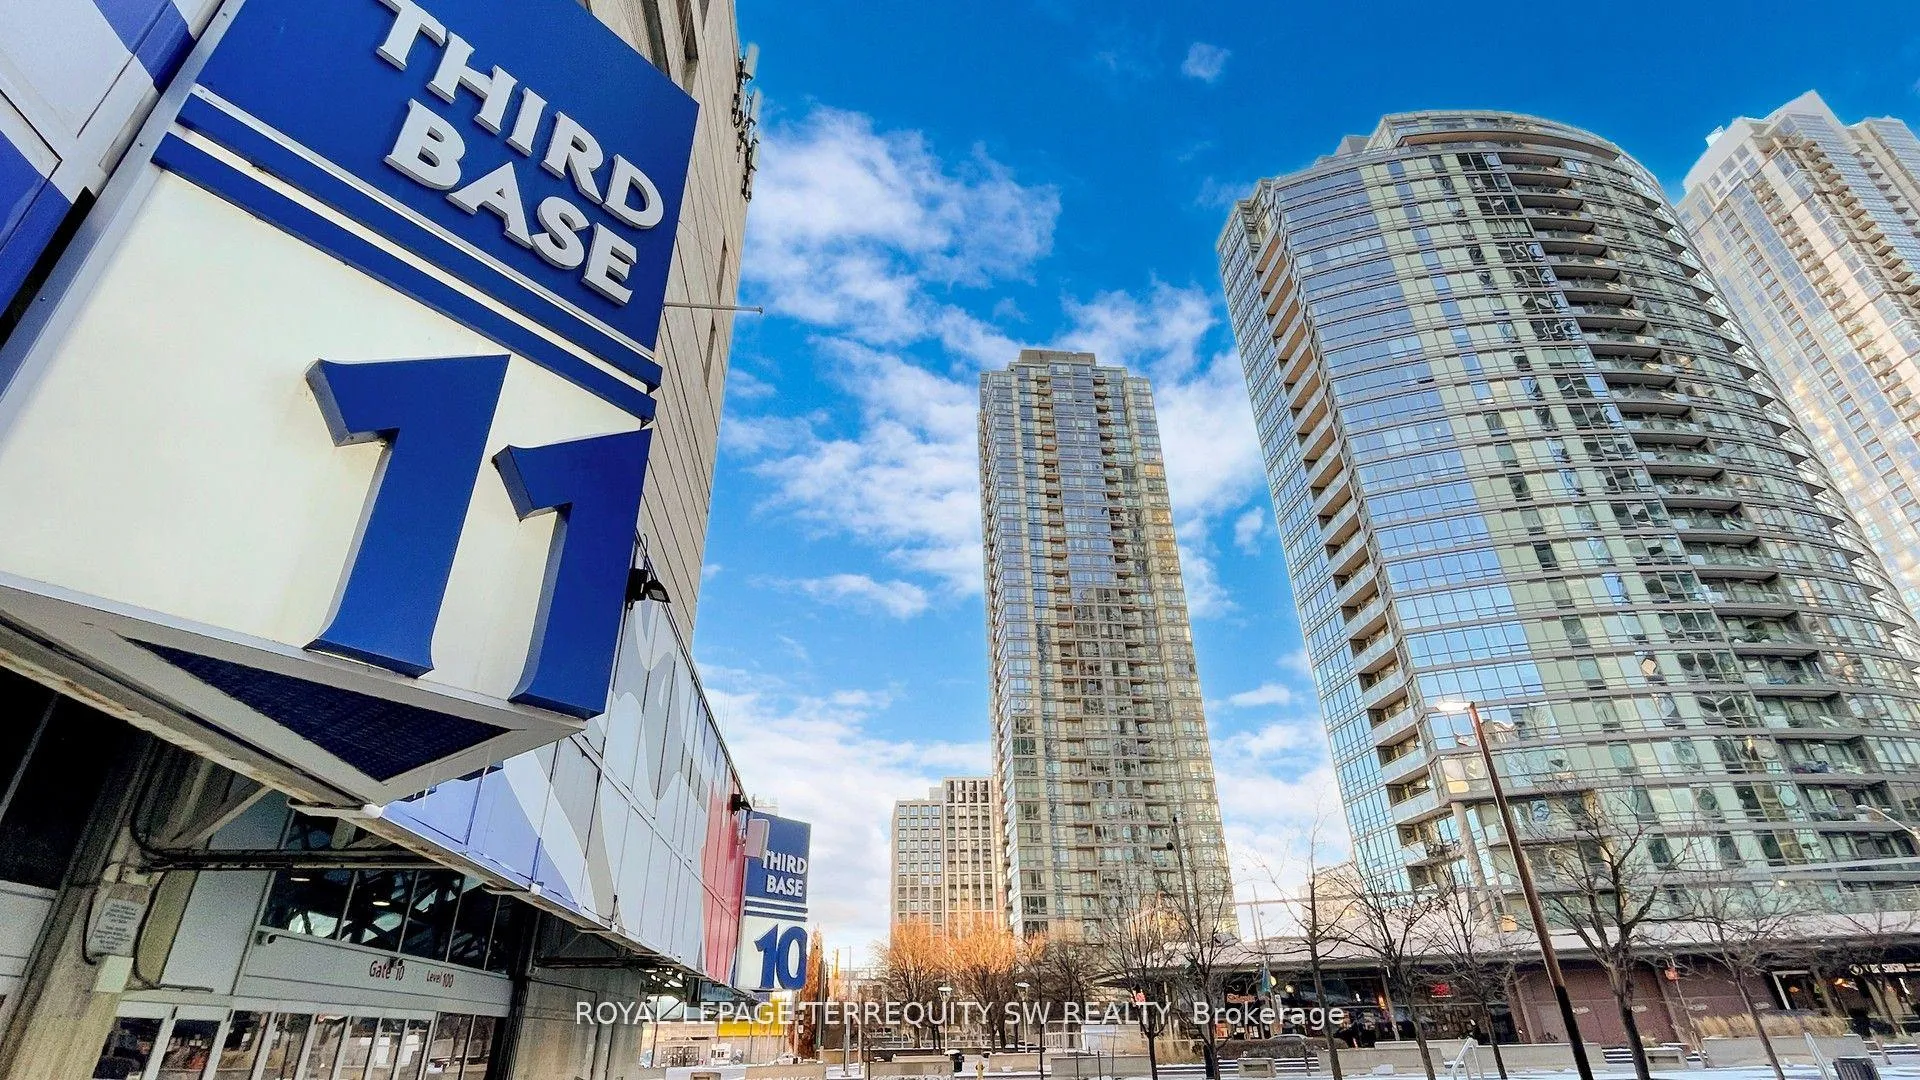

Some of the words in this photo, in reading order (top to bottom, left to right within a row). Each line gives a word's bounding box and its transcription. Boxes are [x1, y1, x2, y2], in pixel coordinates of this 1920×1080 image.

[376, 0, 664, 229] THIRD
[384, 98, 637, 306] BASE
[305, 354, 653, 721] 11
[762, 850, 808, 875] THIRD
[766, 874, 804, 897] BASE
[369, 960, 392, 980] Gate
[394, 964, 405, 981] 10
[426, 970, 443, 983] Level
[442, 973, 454, 988] 100
[754, 923, 808, 990] 10
